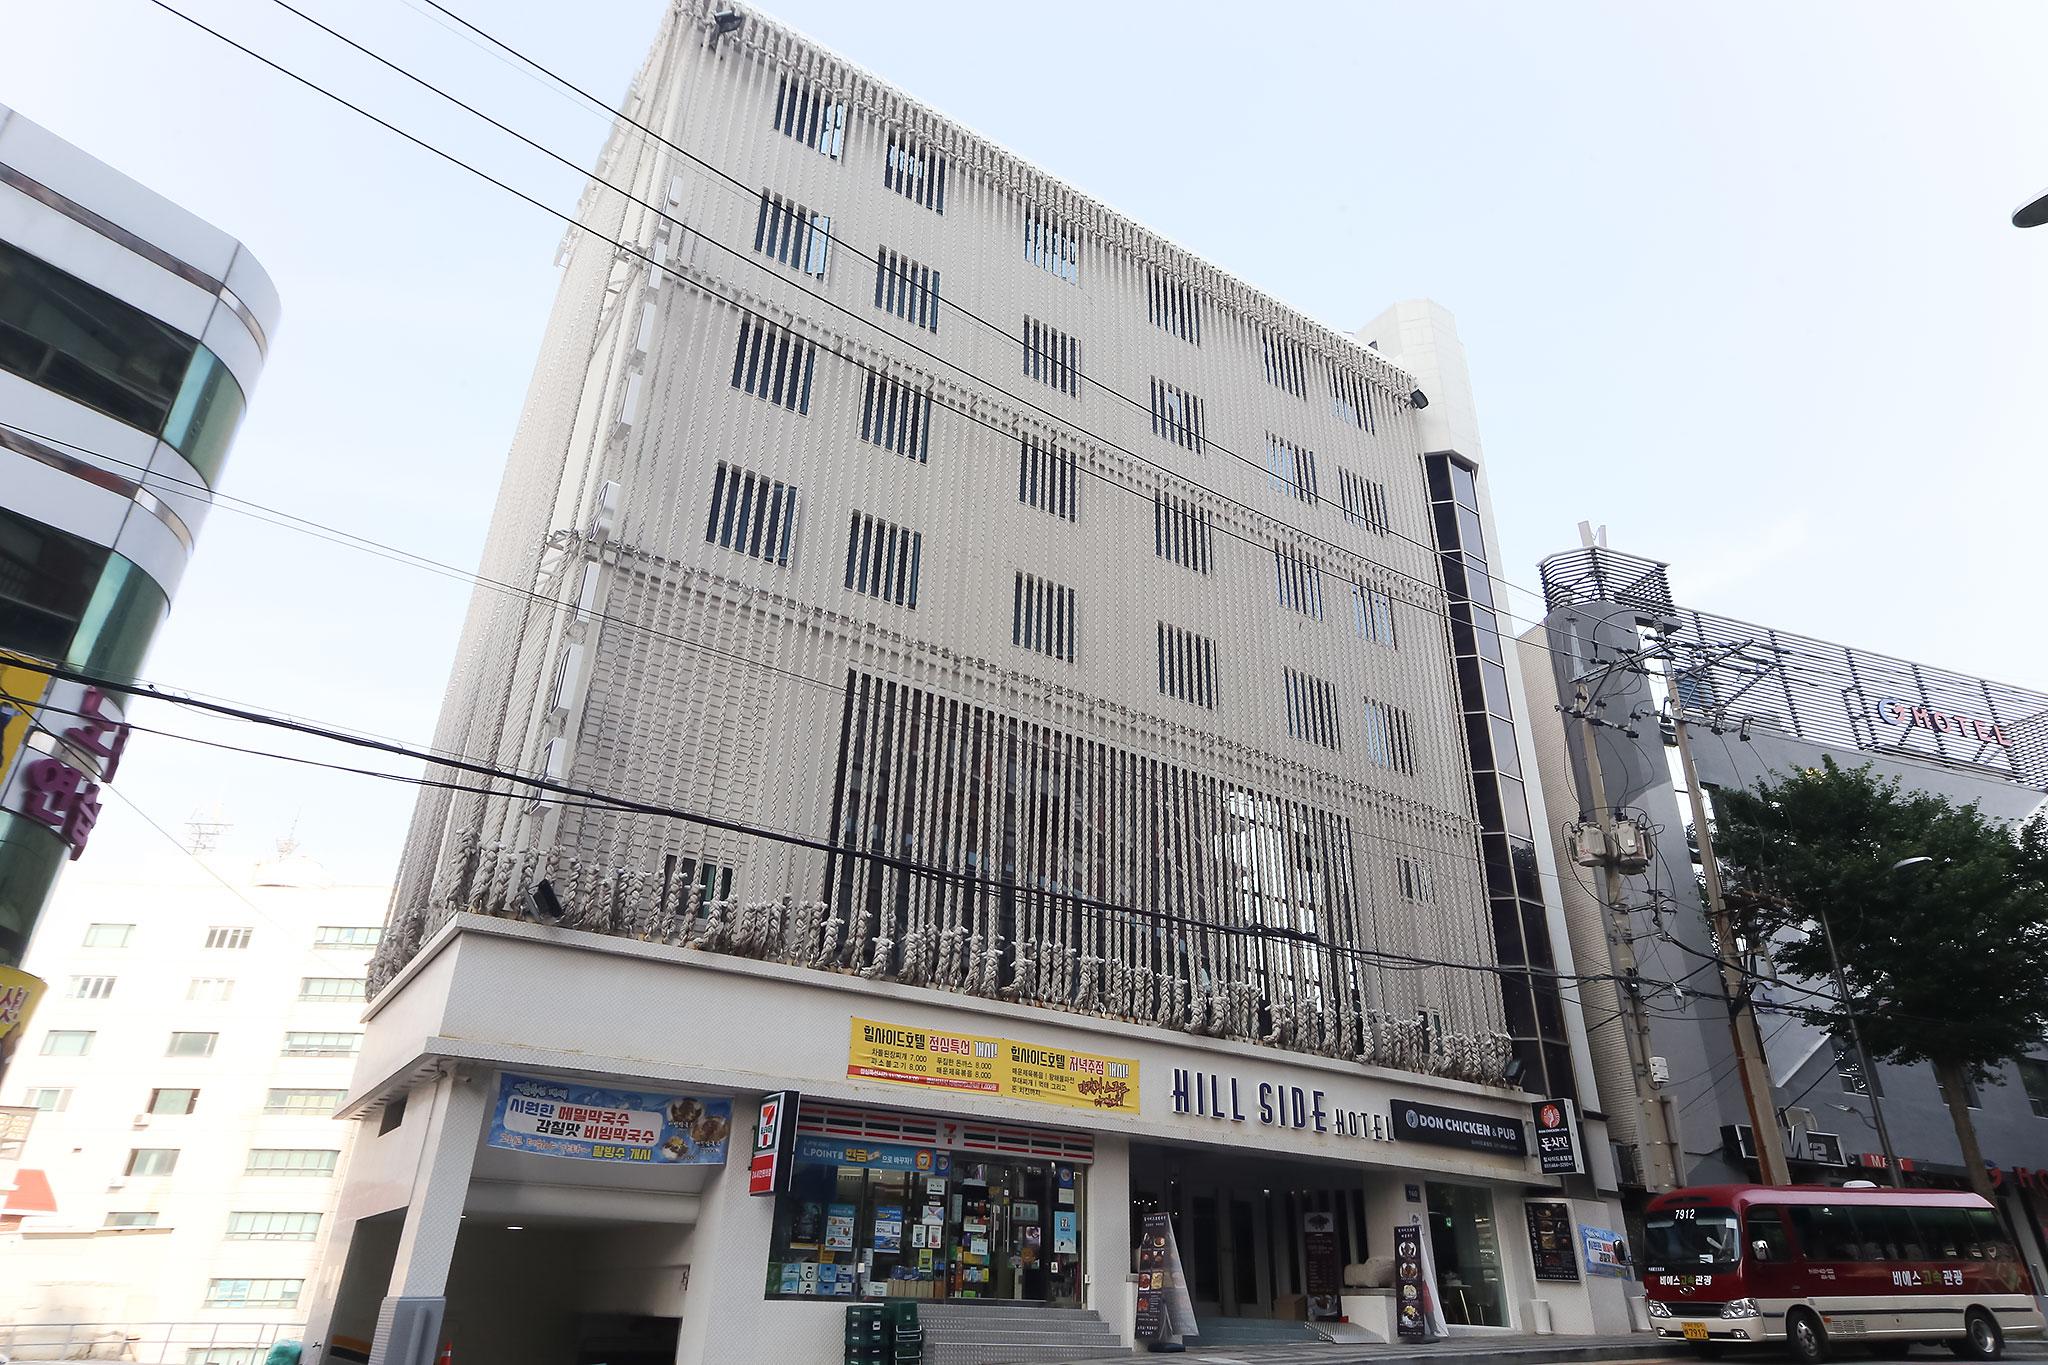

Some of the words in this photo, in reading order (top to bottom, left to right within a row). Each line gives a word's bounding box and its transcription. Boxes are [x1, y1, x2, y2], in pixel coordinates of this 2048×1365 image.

[1910, 705, 2013, 747] MOTEL
[863, 1024, 926, 1051] 힐사이드호텔
[929, 1035, 971, 1055] 점심특선
[1010, 1045, 1066, 1070] 힐사이드호텔
[1069, 1056, 1105, 1075] 저녁주점
[1051, 1082, 1067, 1092] 그리고
[510, 1098, 555, 1119] 시원한
[558, 1106, 630, 1126] 메밀막국수
[1172, 1068, 1246, 1122] HILL
[1259, 1081, 1328, 1133] SIDE
[1333, 1107, 1396, 1142] HOTEL
[536, 1118, 581, 1138] 감칠맛
[583, 1124, 655, 1144] 비빔막국수
[1419, 1114, 1444, 1130] DON
[1445, 1118, 1491, 1137] CHICKEN
[1492, 1127, 1498, 1137] &
[1497, 1126, 1517, 1141] PUB
[630, 1146, 651, 1161] 개시
[1541, 1136, 1569, 1152] 돈치킨
[1870, 1154, 1904, 1170] MAT
[1675, 1208, 1696, 1220] 7912
